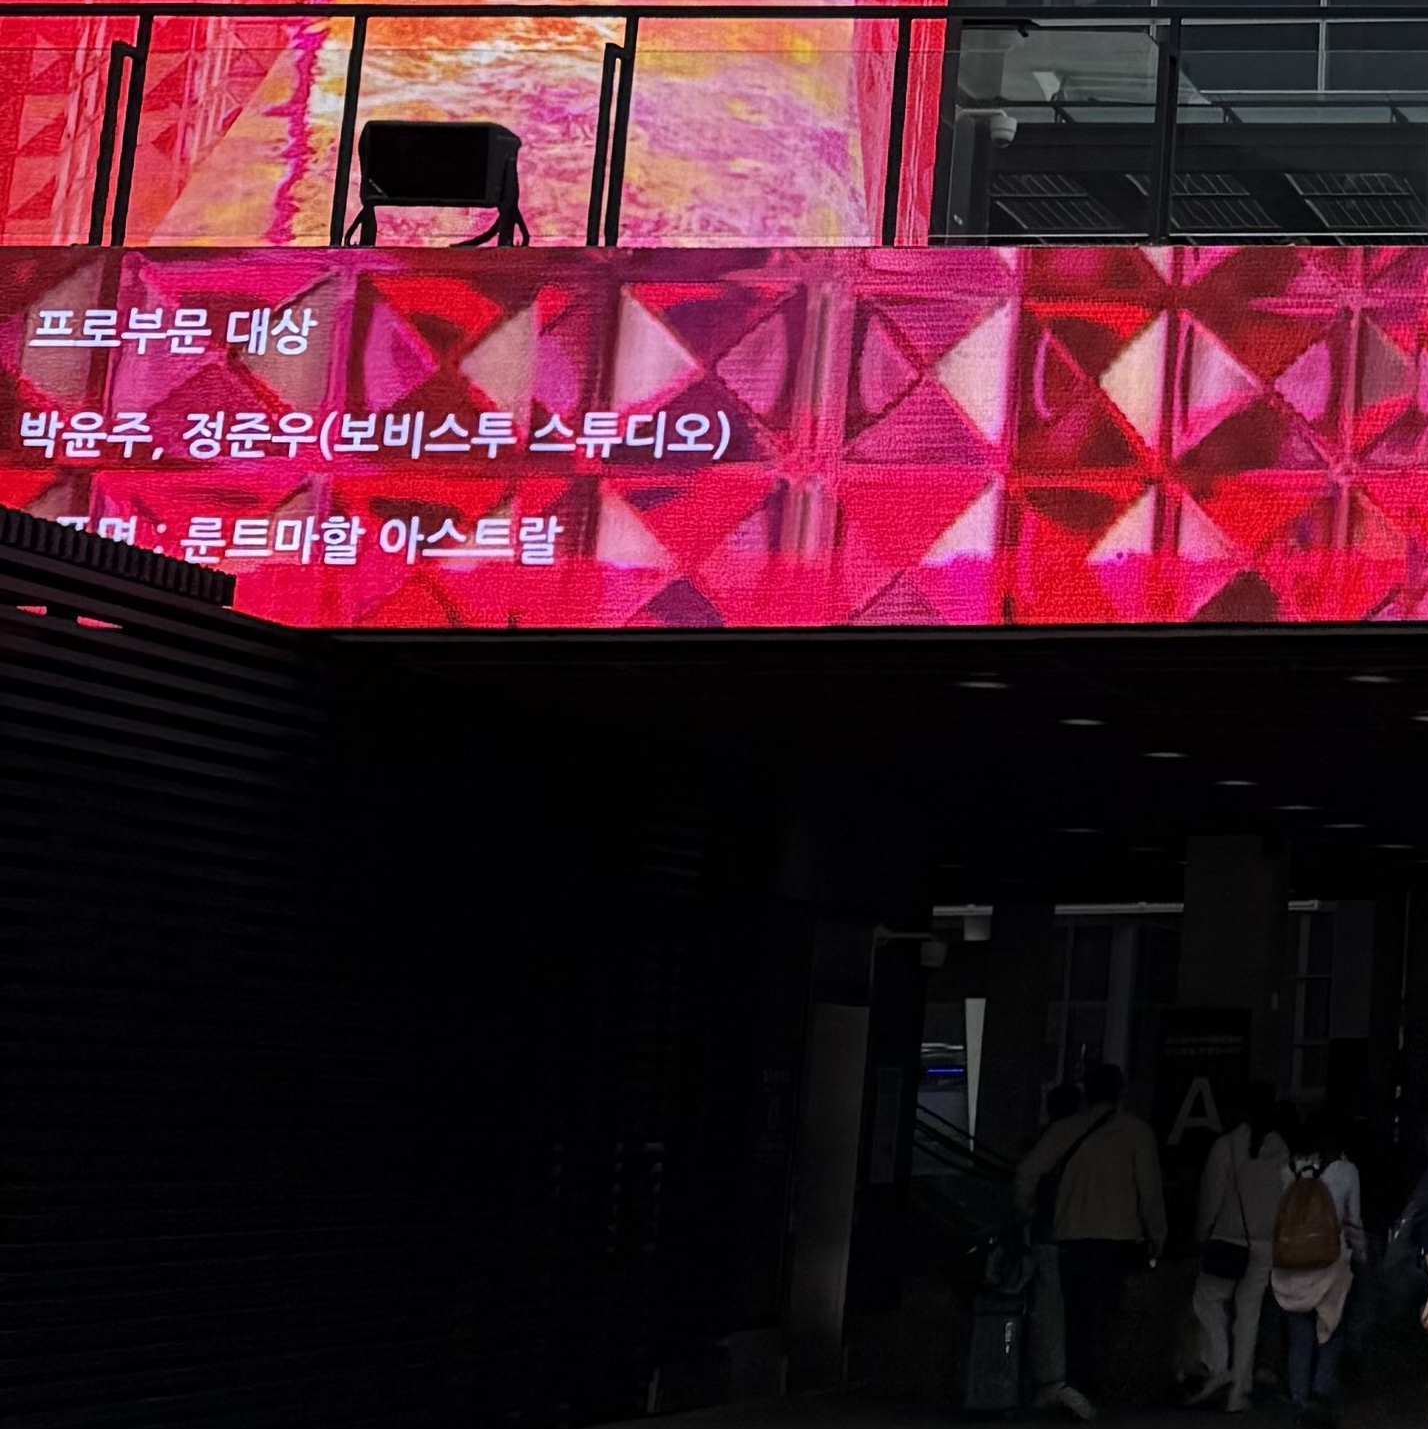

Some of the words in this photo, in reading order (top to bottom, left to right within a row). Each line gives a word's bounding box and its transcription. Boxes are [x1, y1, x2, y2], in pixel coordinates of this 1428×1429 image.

[28, 307, 212, 355] 프로부문
[226, 307, 318, 356] 대상
[20, 410, 164, 460] 박윤주,
[182, 410, 518, 460] 정준우(보비스투
[529, 410, 731, 460] 스튜디오)
[180, 515, 367, 566] 룬트마할
[379, 515, 564, 566] 아스트랄
[1165, 1075, 1224, 1146] A
